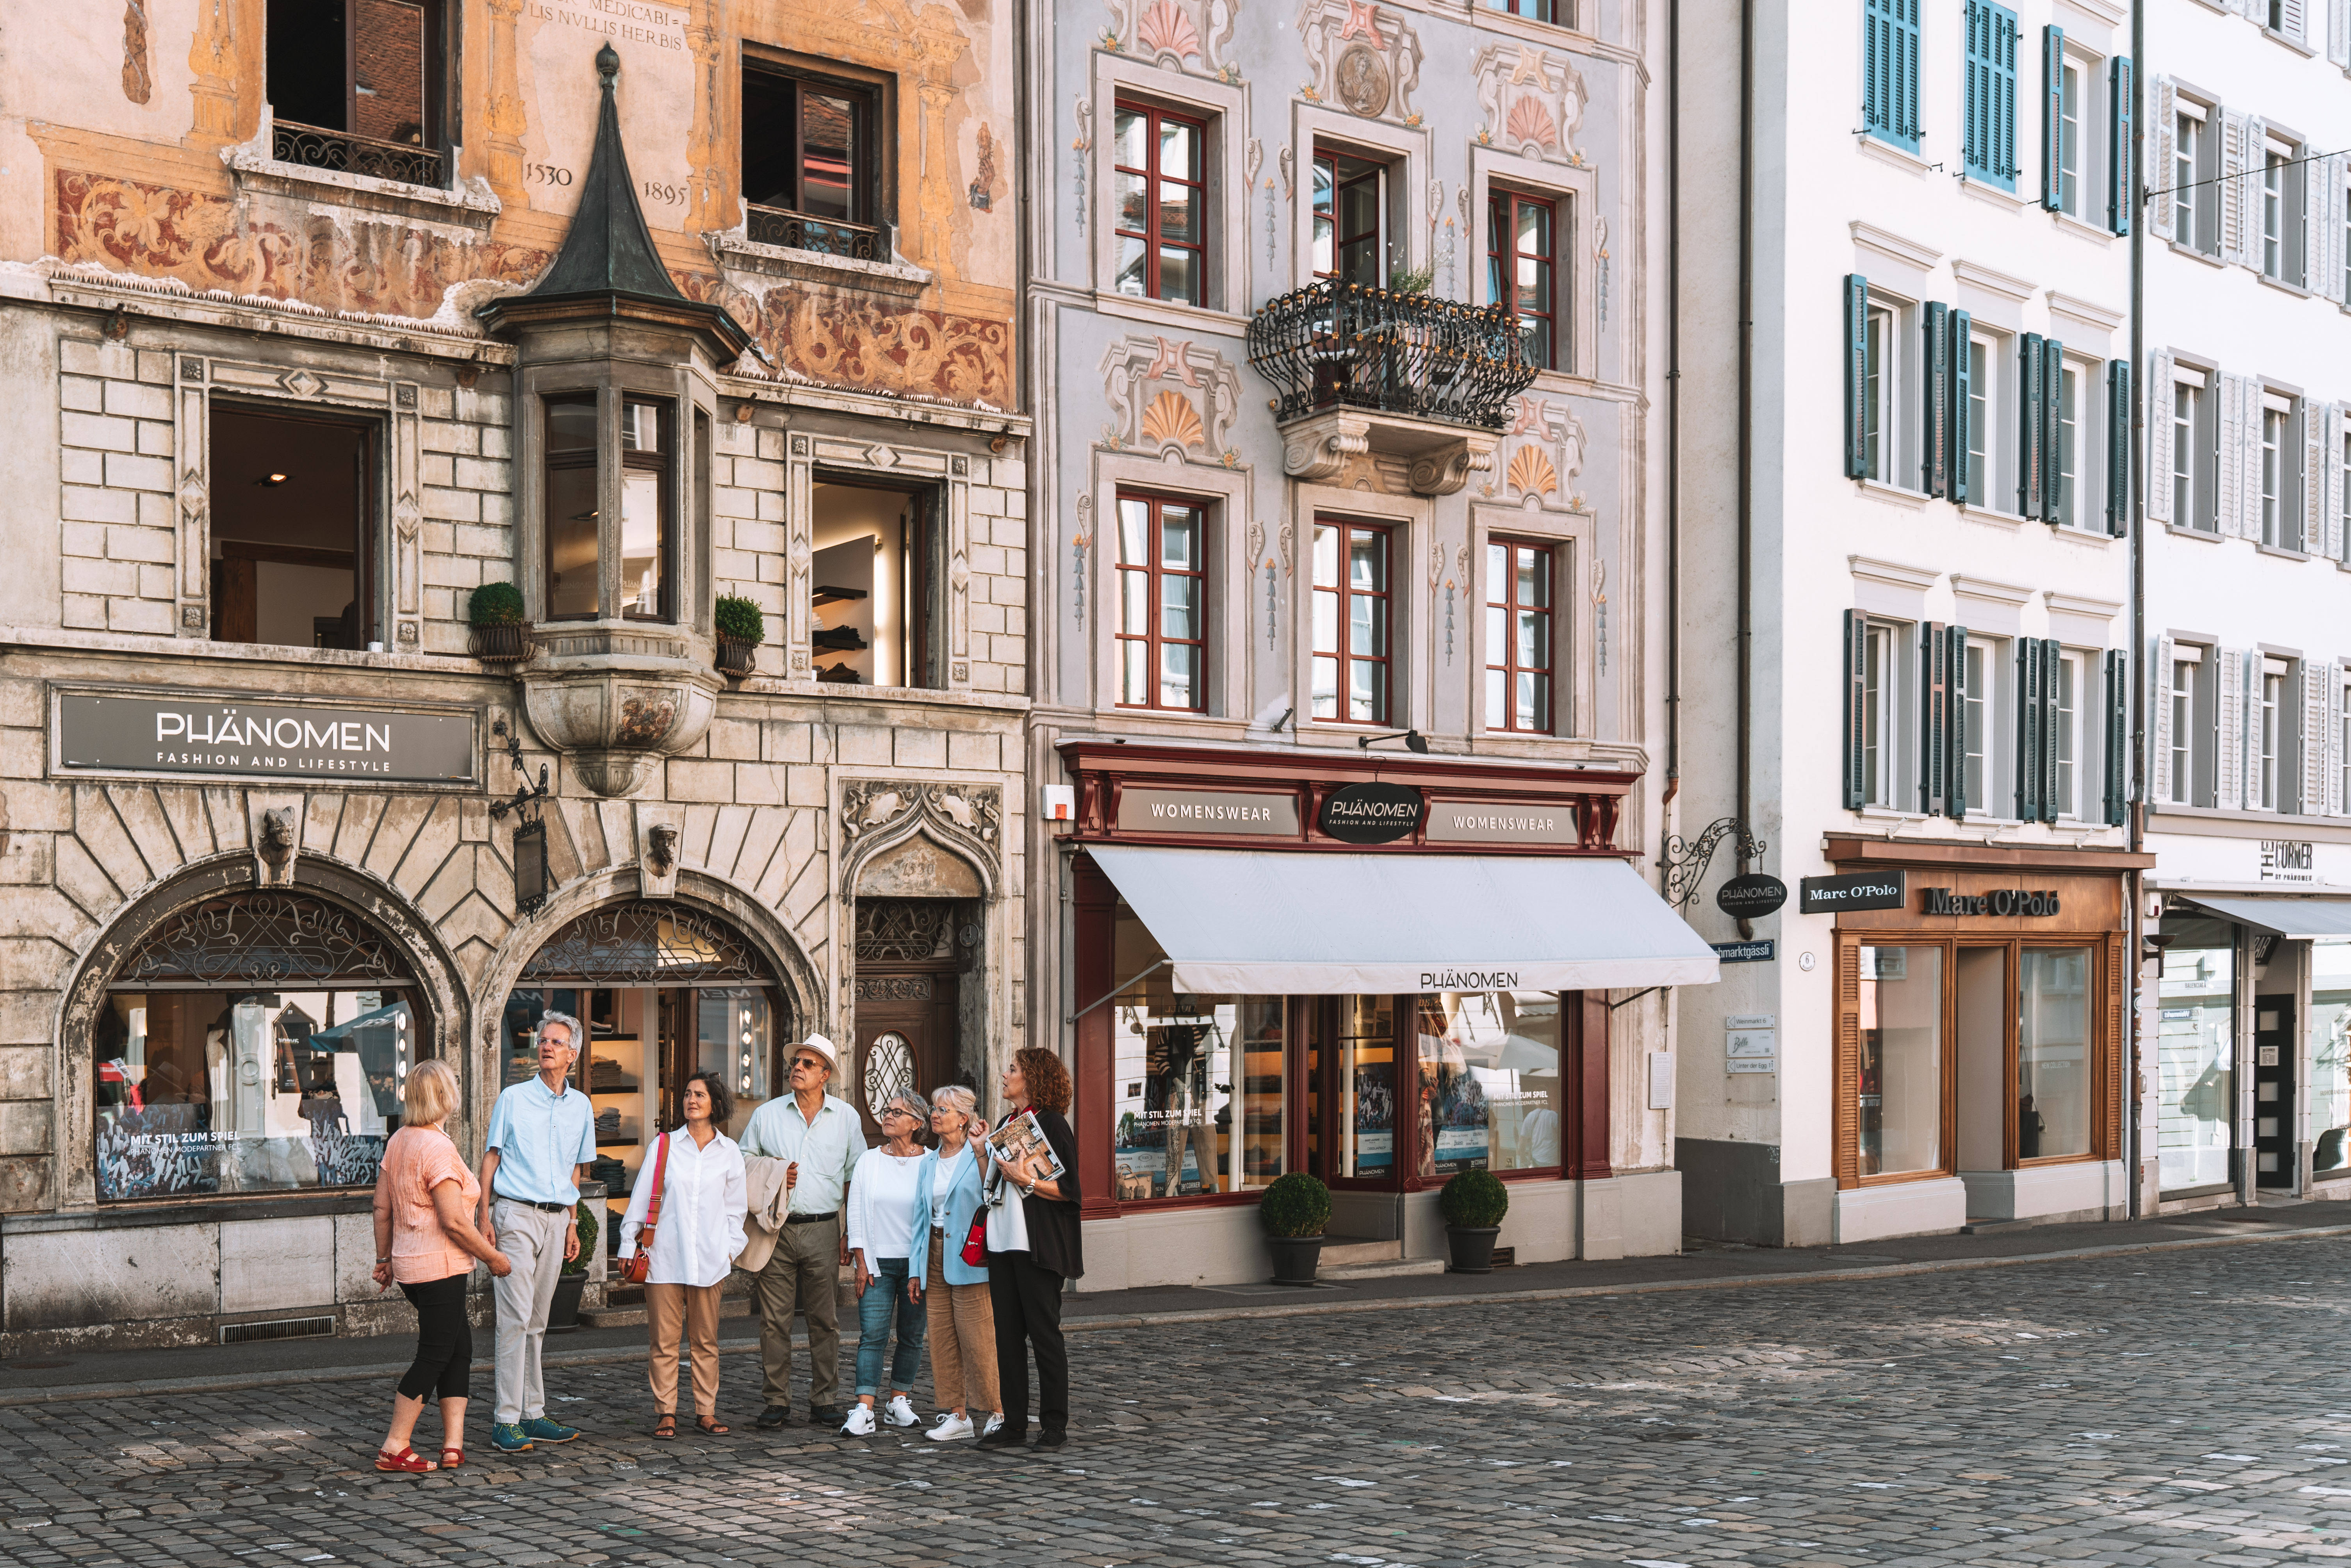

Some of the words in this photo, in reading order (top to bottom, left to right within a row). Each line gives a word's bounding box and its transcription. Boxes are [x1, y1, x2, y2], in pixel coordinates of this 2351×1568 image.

[530, 3, 553, 21] LIS
[559, 10, 616, 35] NVLLIS
[622, 24, 681, 51] HERBIS
[526, 162, 572, 185] 1530
[644, 182, 687, 206] 1895
[157, 709, 390, 752] PHÄNOMEN
[157, 752, 239, 766] FASHION
[251, 756, 287, 767] AND
[299, 758, 390, 772] LIFESTYLE
[1151, 804, 1270, 821] WOMENSWEAR
[1331, 799, 1417, 817] PHÄNOMEN
[1453, 816, 1553, 830] WOMENSWEAR
[2261, 841, 2274, 880] THE
[2276, 841, 2312, 869] CORNER
[1722, 886, 1781, 900] PHÄNOMEN
[1810, 889, 1847, 900] Marc
[1926, 887, 1988, 915] Marc
[1806, 954, 1809, 964] 6
[1421, 969, 1517, 989] PHÄNOMEN
[1733, 1035, 1748, 1053] Belle
[1134, 1111, 1147, 1119] MIT
[1165, 1110, 1181, 1118] ZUM
[131, 1135, 152, 1145] MIT
[155, 1134, 178, 1144] STIL
[182, 1132, 207, 1143] ZUM
[211, 1131, 240, 1141] SPIEL
[175, 1144, 226, 1153] MODEPARTNER
